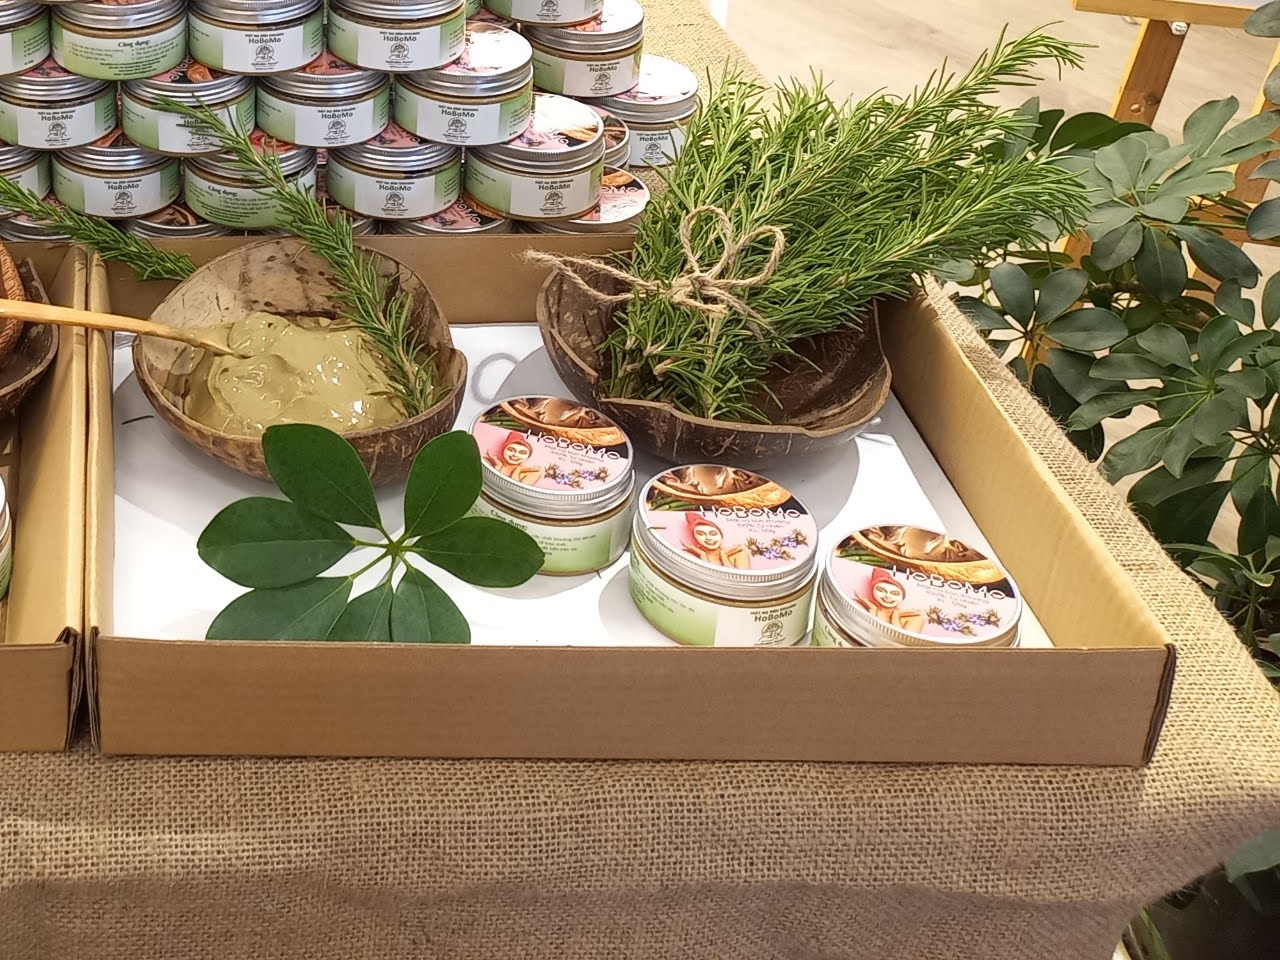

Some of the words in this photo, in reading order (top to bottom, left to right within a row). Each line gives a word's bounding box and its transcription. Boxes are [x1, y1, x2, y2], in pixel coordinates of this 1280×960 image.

[248, 36, 282, 45] HoBoMo
[383, 34, 417, 43] HoBoMo
[40, 114, 74, 122] HoBoMo
[321, 111, 354, 120] HoBoMo
[441, 109, 475, 119] HoBoMo
[108, 182, 140, 191] HoBoMo
[378, 184, 412, 192] HoBoMo
[538, 182, 571, 192] HoBoMo
[754, 610, 793, 622] HoBoMo
